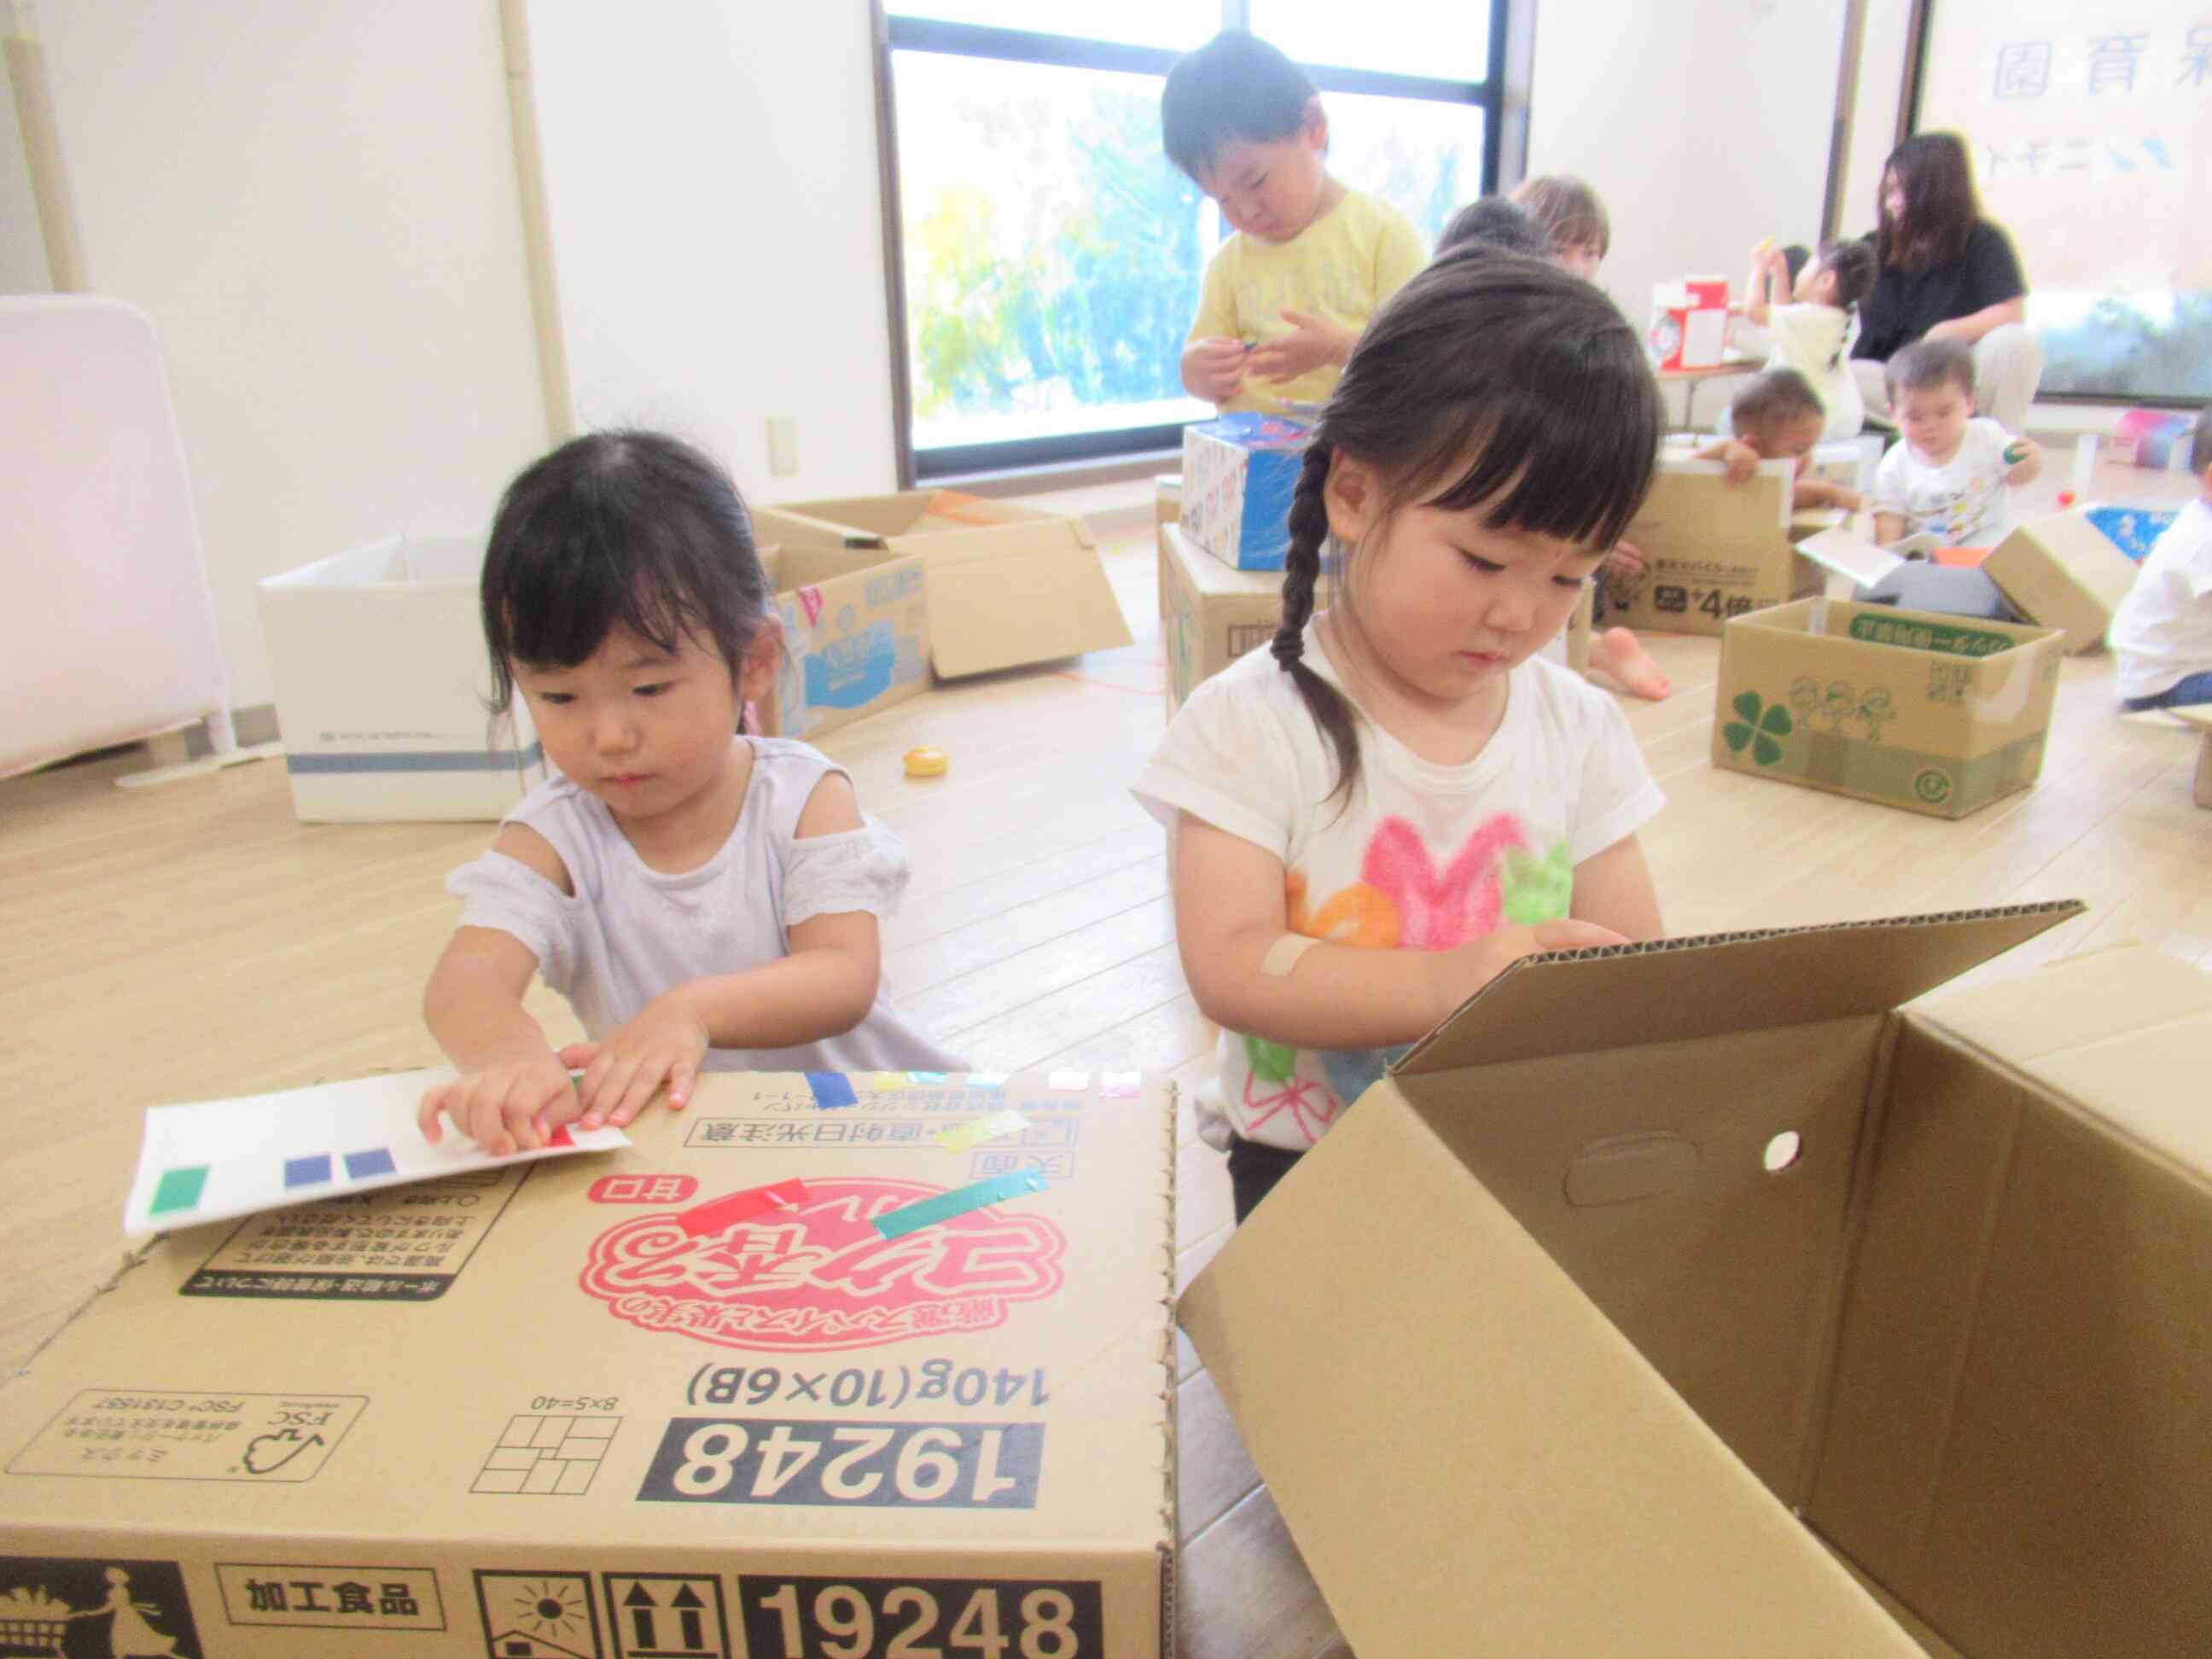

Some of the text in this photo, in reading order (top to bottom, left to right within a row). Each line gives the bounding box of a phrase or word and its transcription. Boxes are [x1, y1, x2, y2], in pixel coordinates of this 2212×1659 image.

[602, 1178, 684, 1201] 甘口
[604, 1224, 1040, 1298] コク香る
[268, 1411, 334, 1426] FSC
[673, 1423, 1017, 1500] 19248
[246, 1580, 419, 1617] 加工食品
[760, 1584, 1079, 1659] 19248
